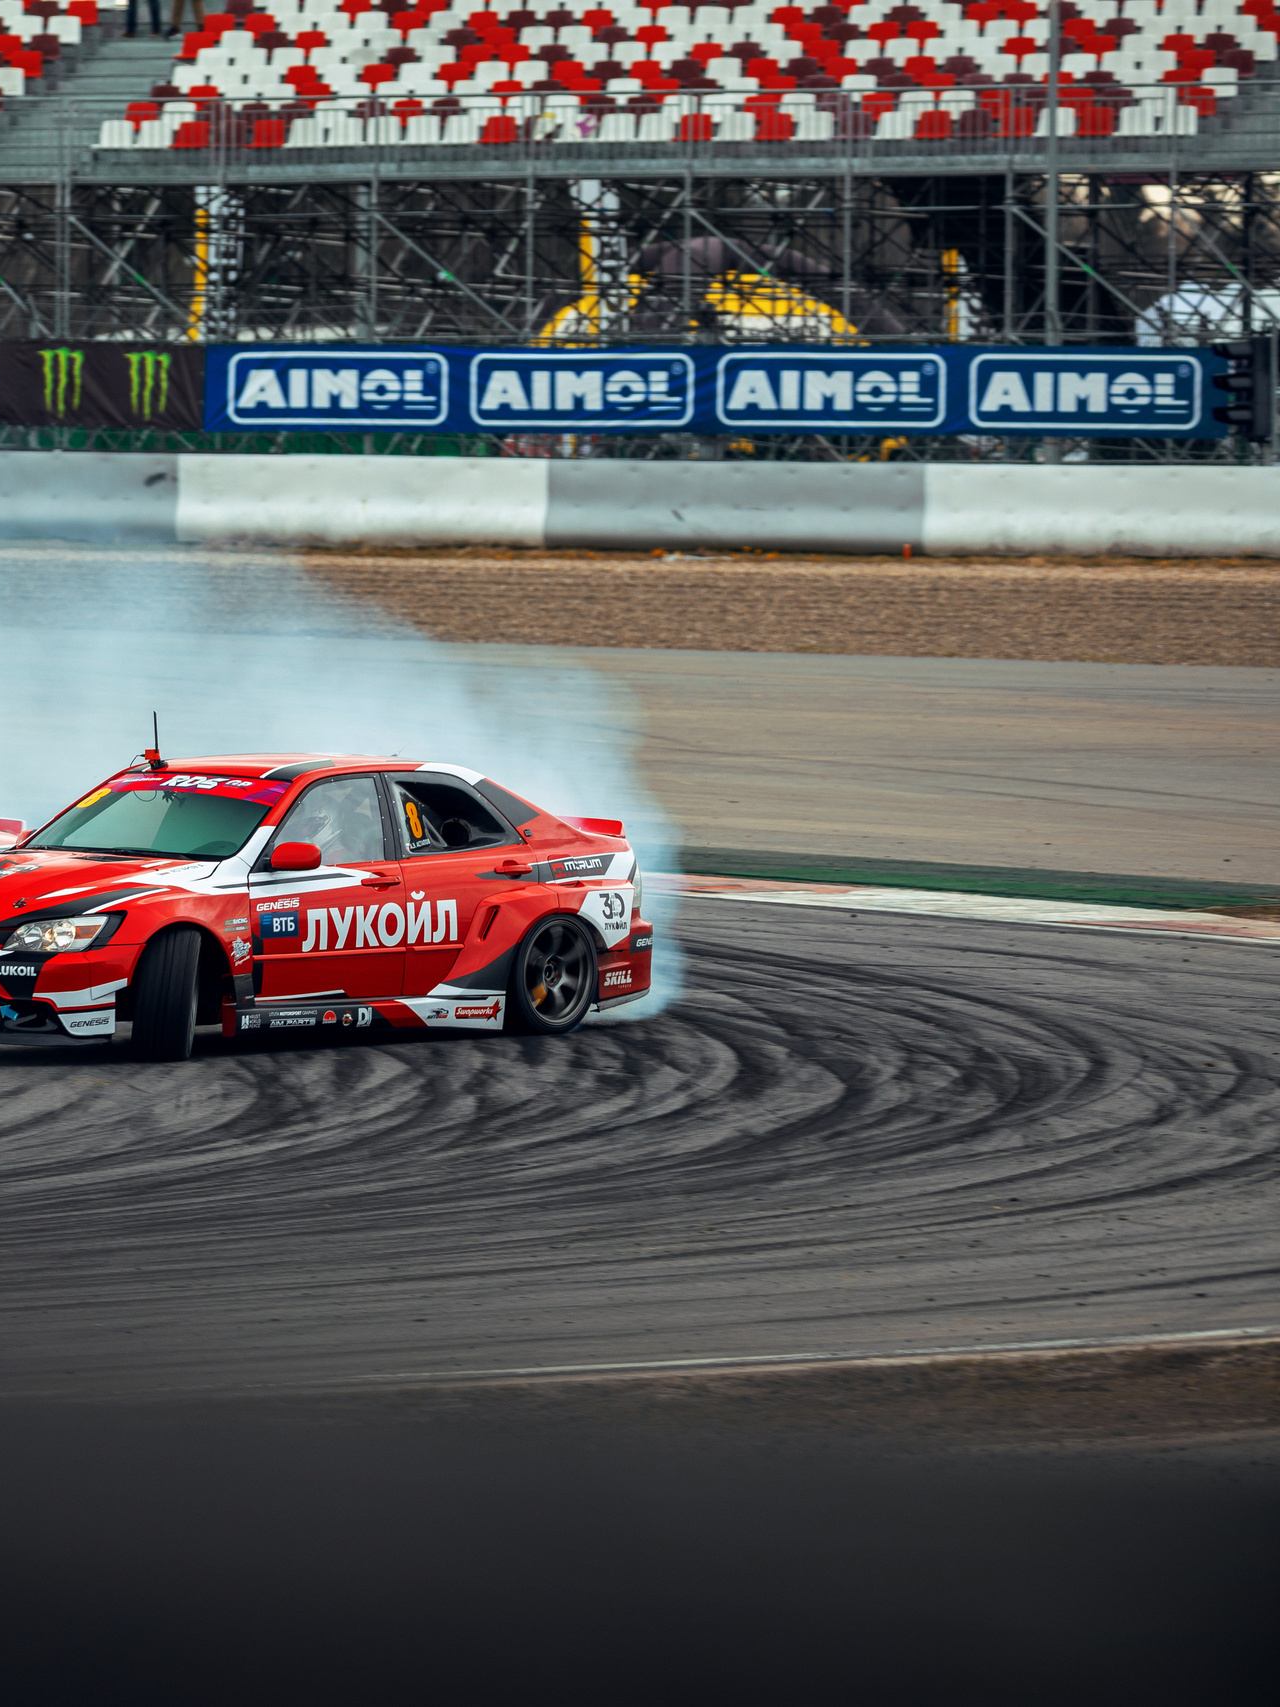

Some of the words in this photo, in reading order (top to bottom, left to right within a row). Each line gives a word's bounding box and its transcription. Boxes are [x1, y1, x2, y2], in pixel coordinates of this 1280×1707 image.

[237, 369, 437, 410] AIMOL
[480, 370, 683, 411] AIMOL
[726, 370, 935, 412] AIMOL
[979, 371, 1190, 414] AIMOL
[160, 775, 230, 789] RDS
[405, 802, 423, 838] 8
[256, 900, 300, 912] GENESIS
[272, 916, 295, 932] ВТБ
[302, 890, 458, 952] ЛУКОЙЛ
[70, 1018, 110, 1028] GENESIS
